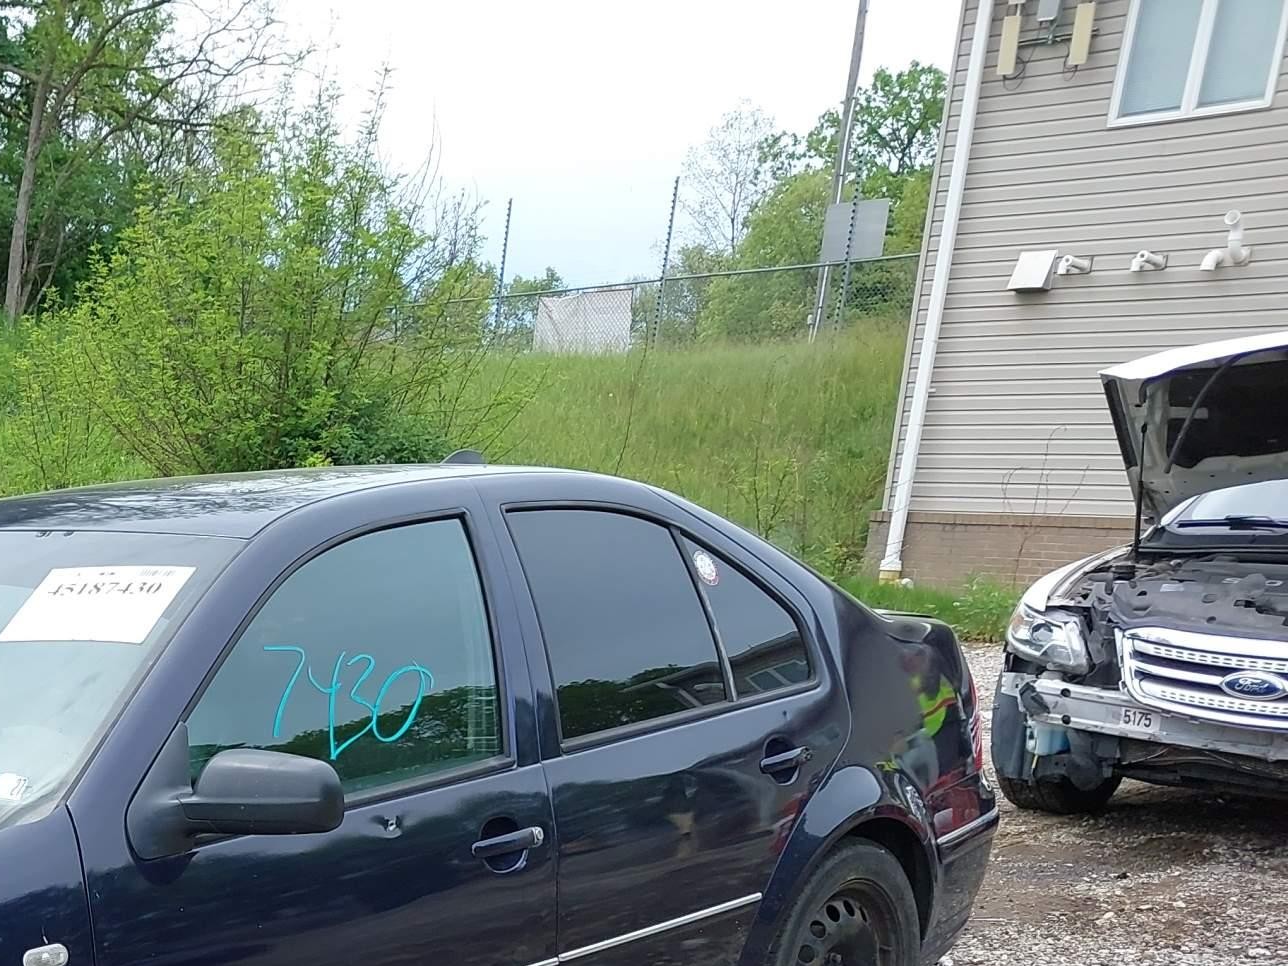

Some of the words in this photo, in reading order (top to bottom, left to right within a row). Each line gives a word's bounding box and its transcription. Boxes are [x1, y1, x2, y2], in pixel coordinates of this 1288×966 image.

[48, 581, 163, 596] 45187430
[1234, 676, 1270, 693] Ford
[263, 645, 434, 760] 7430
[1122, 708, 1153, 729] 5175
